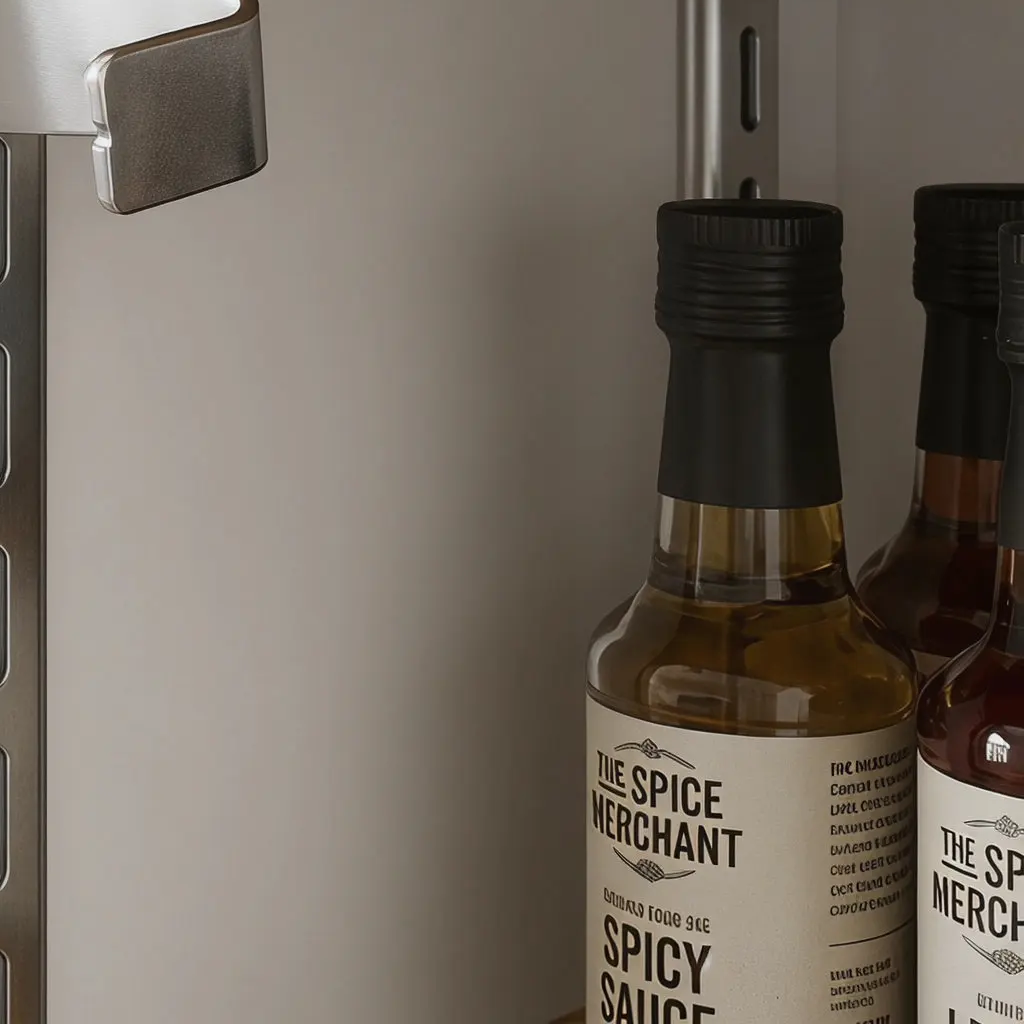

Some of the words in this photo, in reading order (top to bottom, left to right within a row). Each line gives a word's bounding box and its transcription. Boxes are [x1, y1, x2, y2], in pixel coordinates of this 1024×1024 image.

[631, 765, 723, 819] SPICE
[941, 826, 975, 869] THE
[604, 914, 712, 994] SPICY
